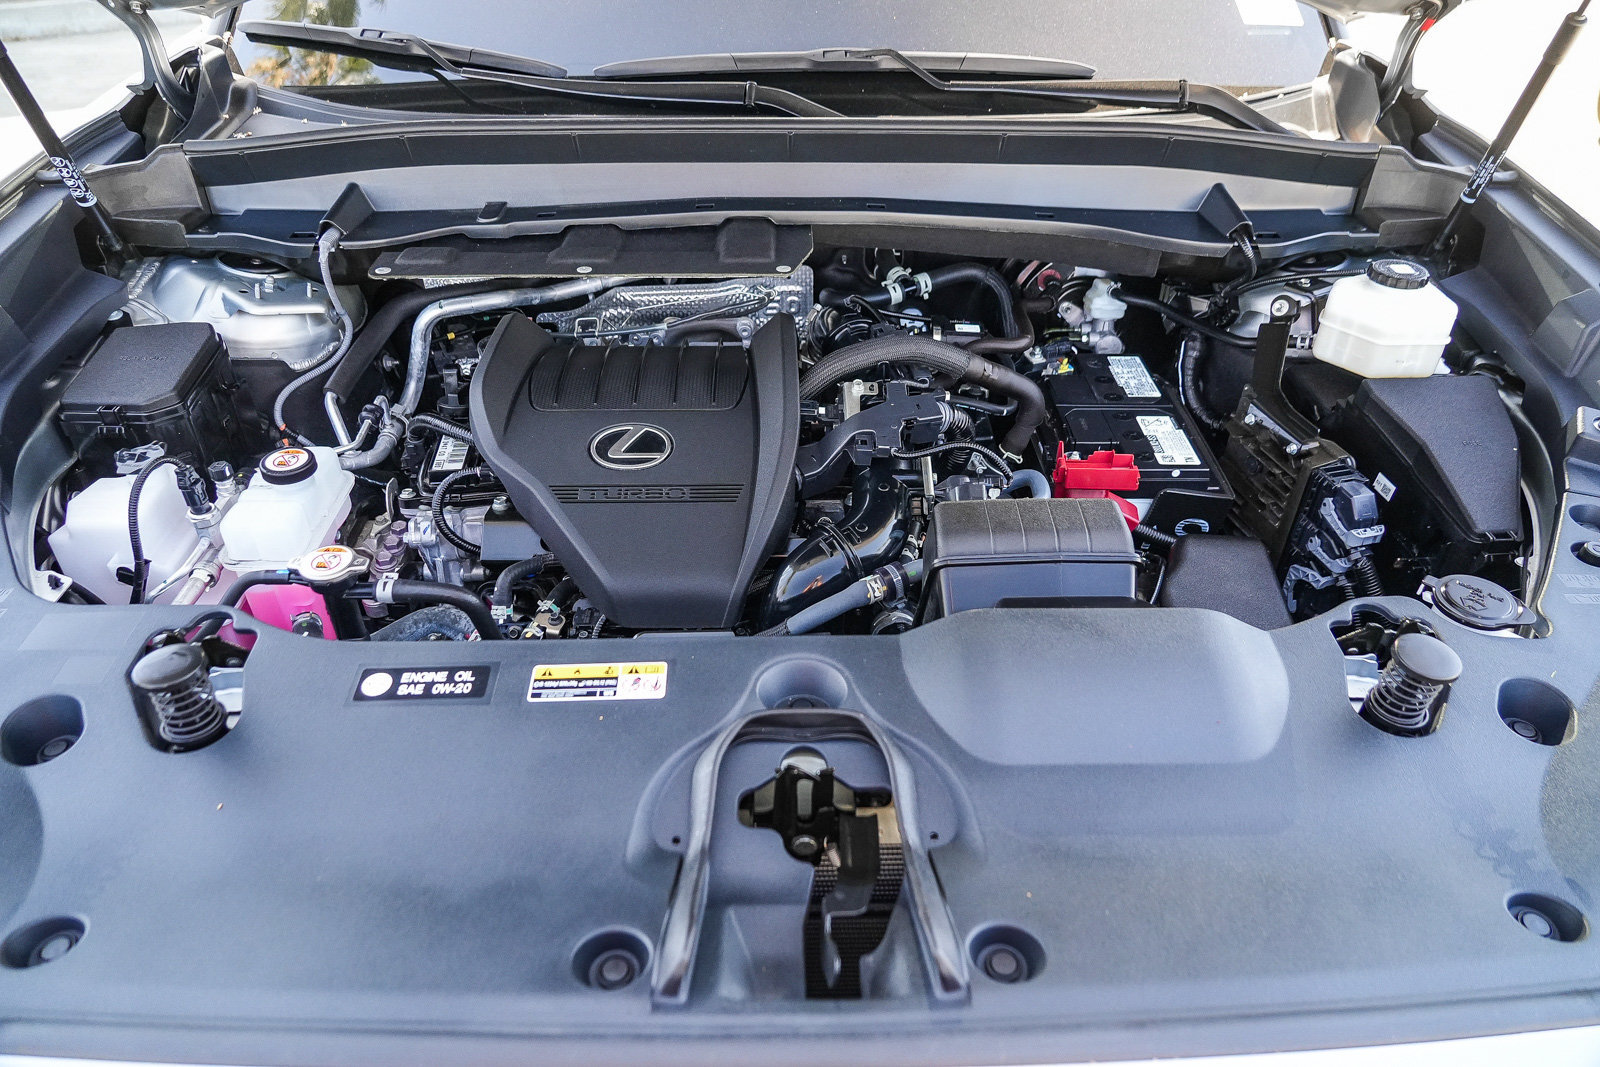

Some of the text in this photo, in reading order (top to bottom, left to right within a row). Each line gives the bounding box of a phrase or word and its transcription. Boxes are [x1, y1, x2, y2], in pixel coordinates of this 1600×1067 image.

[580, 487, 688, 500] TURBO
[400, 670, 476, 683] ENGINE OIL
[396, 682, 473, 695] SAE 0W-20
